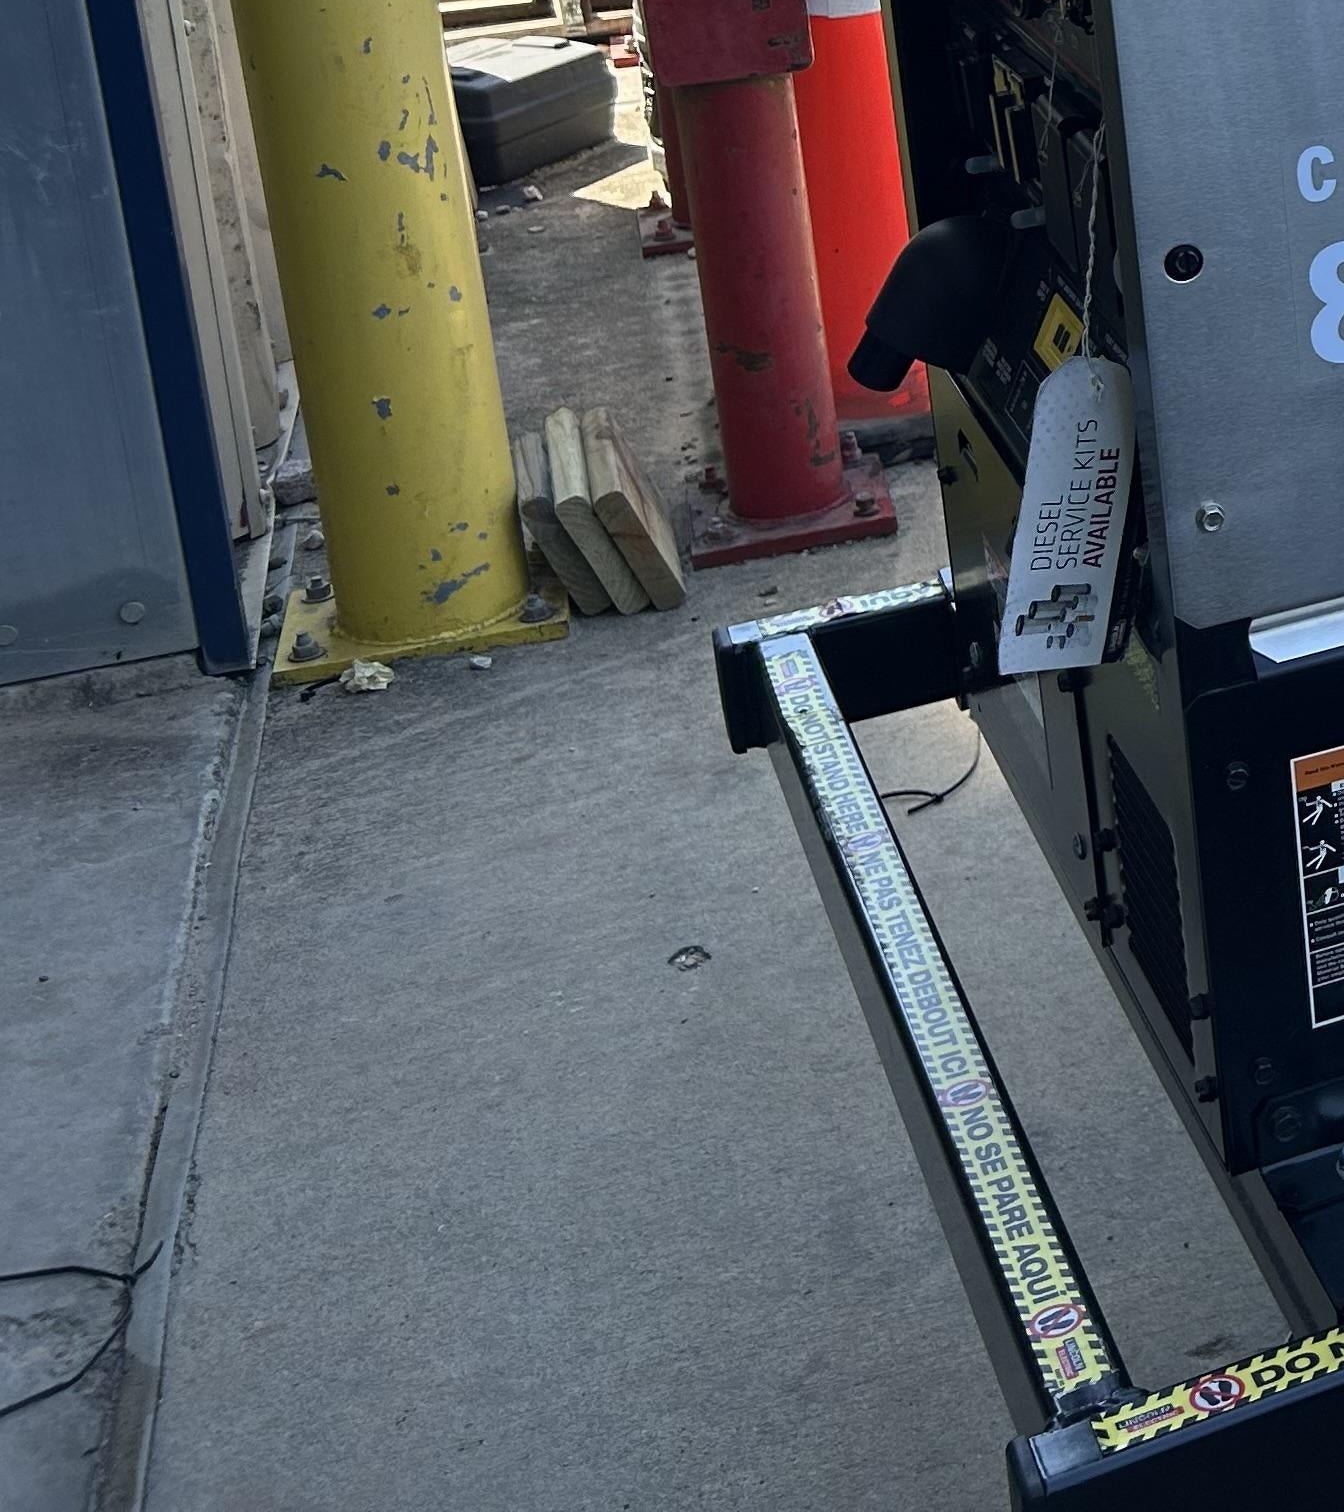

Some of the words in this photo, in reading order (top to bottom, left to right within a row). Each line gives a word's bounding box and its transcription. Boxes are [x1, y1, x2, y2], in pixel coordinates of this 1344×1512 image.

[1073, 419, 1098, 470] KITS
[1056, 479, 1093, 569] SERVICE
[1082, 447, 1120, 568] AVAILABLE
[1030, 494, 1064, 571] DIESEL
[801, 713, 829, 745] NOT
[813, 742, 850, 793] STAND
[831, 792, 869, 834] HERE
[858, 850, 888, 877] NE
[869, 875, 901, 912] PAS
[885, 908, 928, 970] TENEZ
[907, 969, 958, 1047] DEBOUT
[938, 1049, 970, 1080] ICI
[959, 1105, 994, 1142] NO
[974, 1142, 1009, 1176] SE
[986, 1174, 1034, 1242] PARE
[1251, 1352, 1320, 1388] DO
